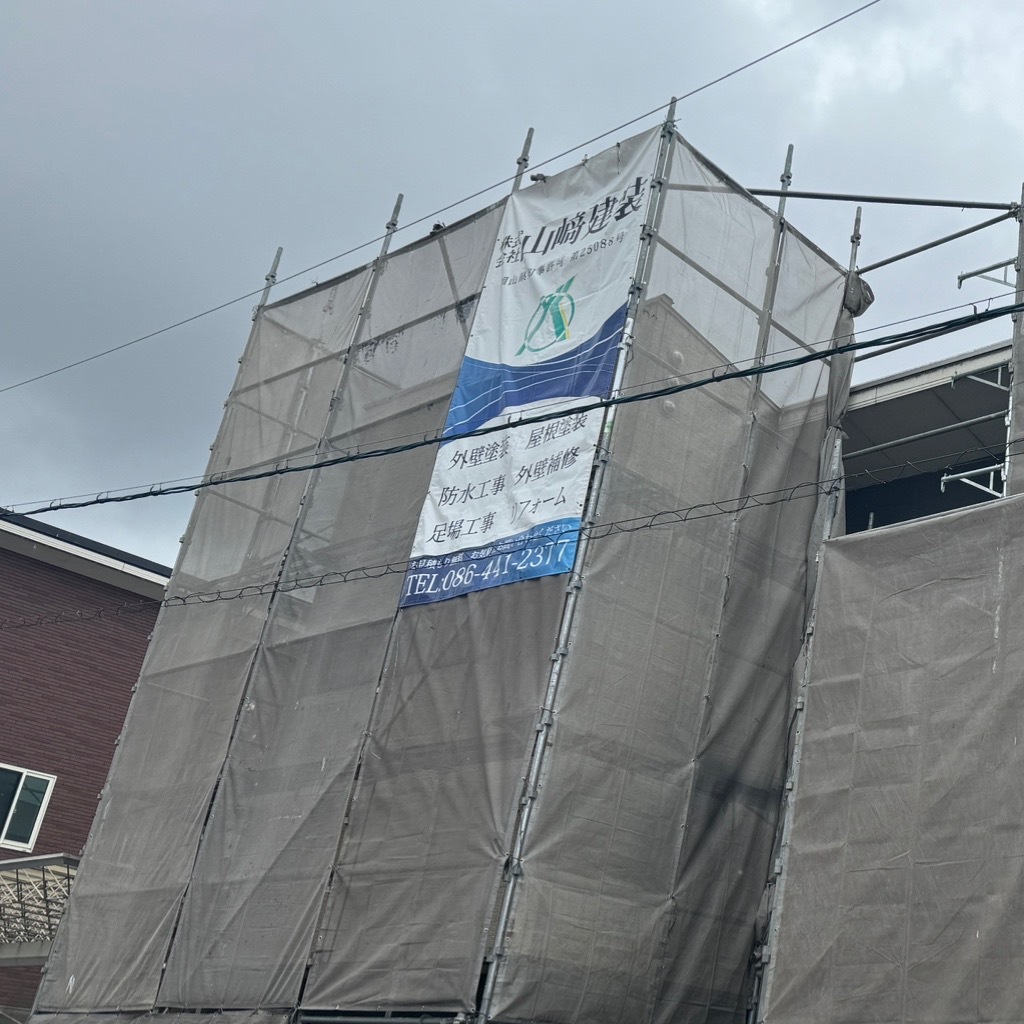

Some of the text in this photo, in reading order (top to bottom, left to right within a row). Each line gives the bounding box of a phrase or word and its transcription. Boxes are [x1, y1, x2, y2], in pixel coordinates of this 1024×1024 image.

[447, 411, 588, 471] 外壁塗装 屋根塗装
[438, 446, 580, 507] 防水工事 外壁補修
[426, 486, 566, 543] 足場工事 リフォーム
[404, 538, 570, 597] TEL:086-441-2377
